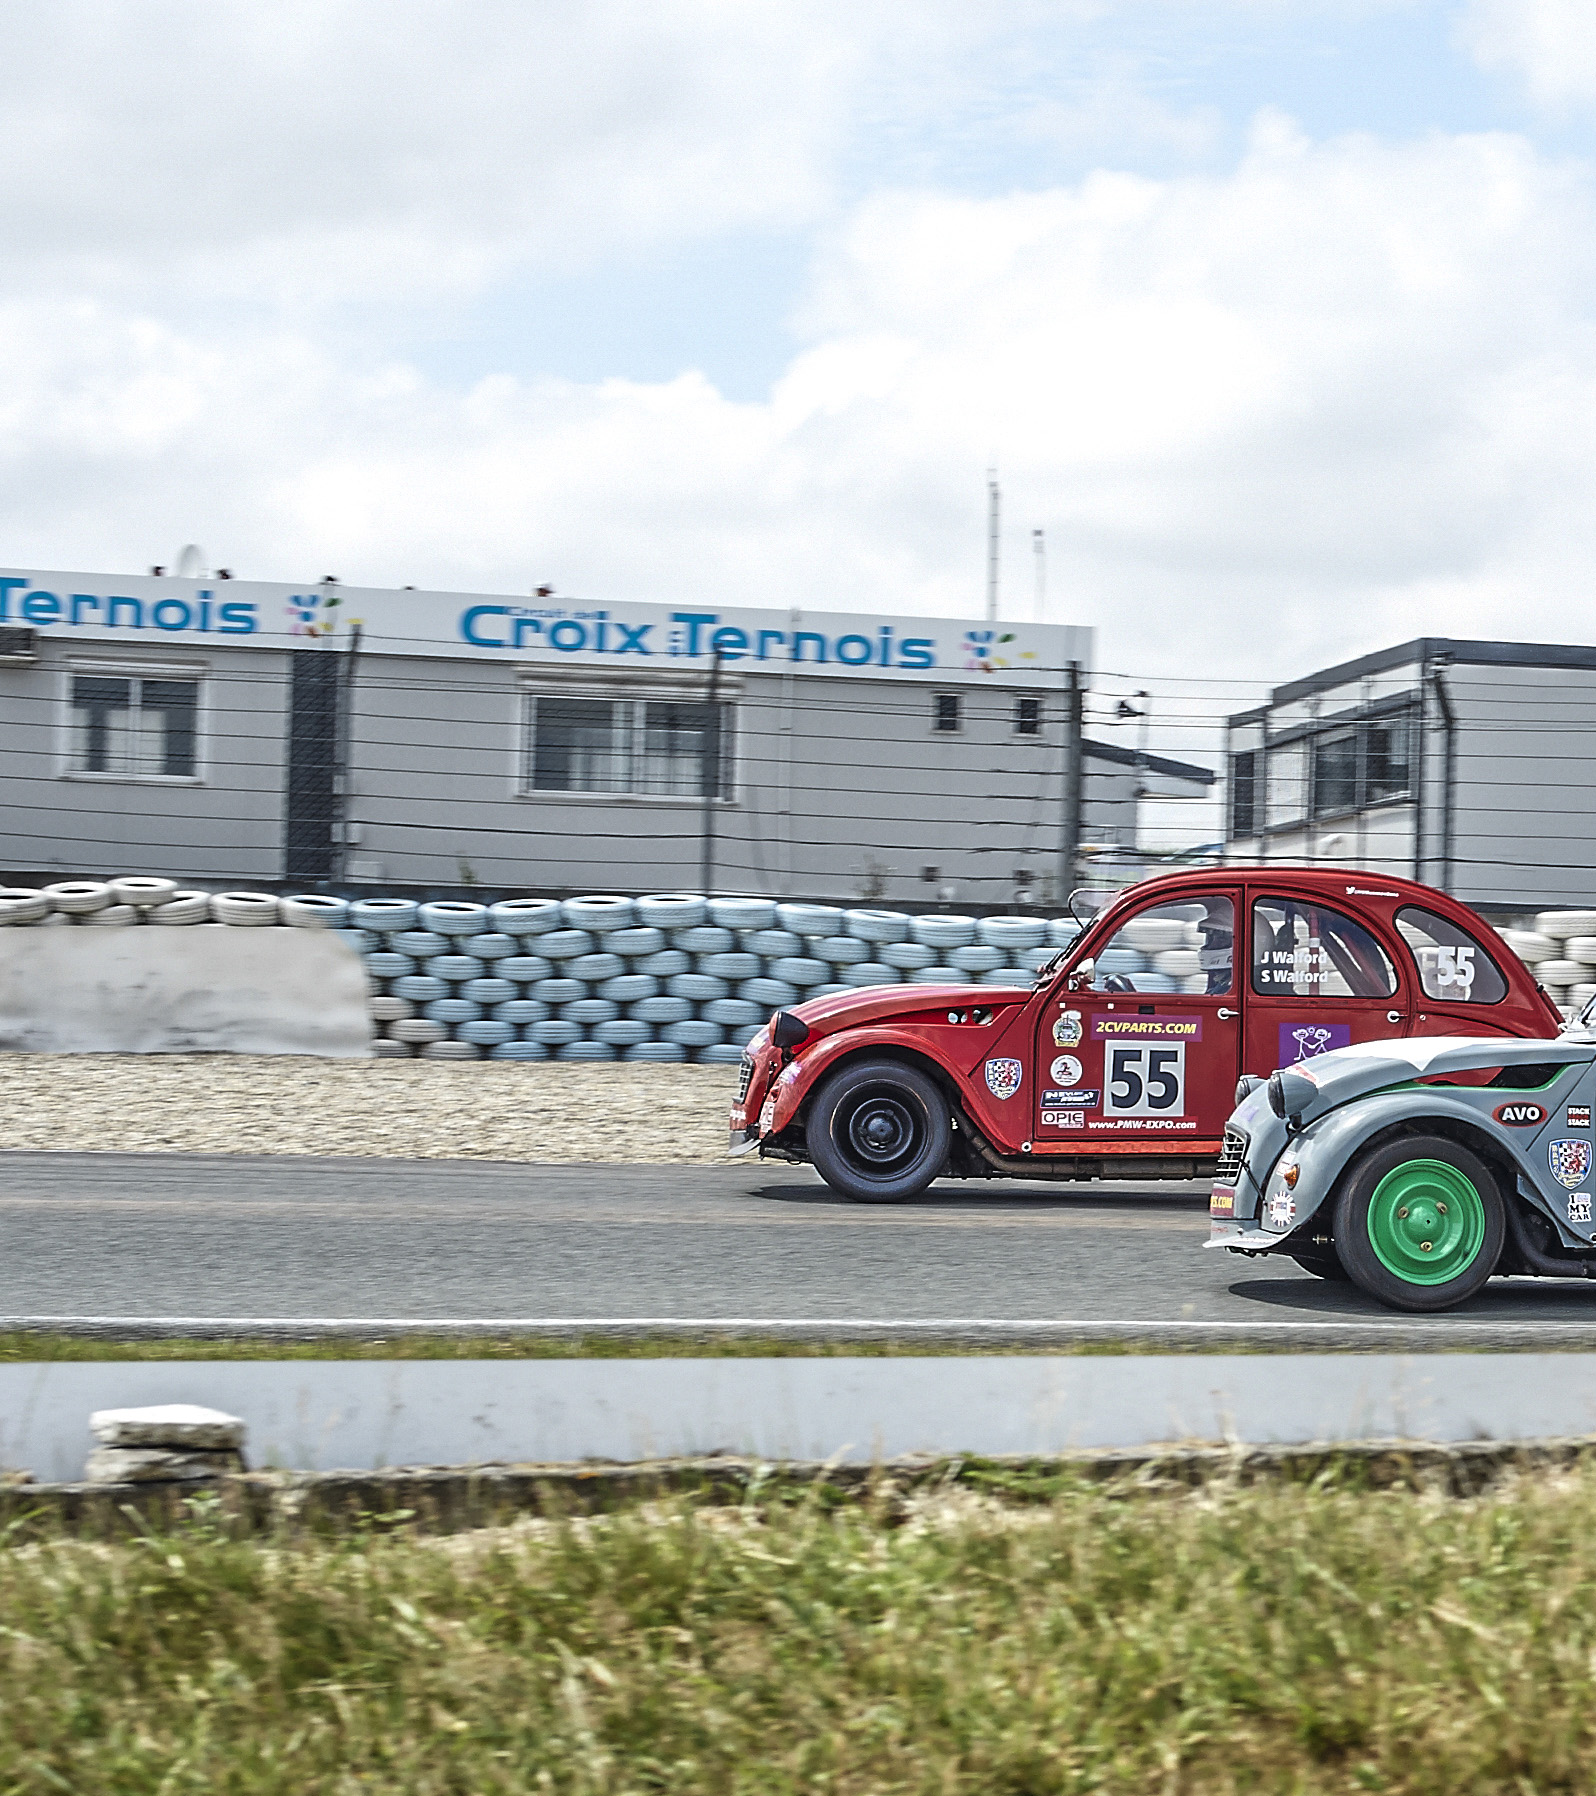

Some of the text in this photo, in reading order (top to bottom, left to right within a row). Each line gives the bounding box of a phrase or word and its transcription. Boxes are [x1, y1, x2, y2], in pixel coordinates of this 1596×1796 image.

[462, 604, 654, 656] Croix
[670, 612, 935, 670] Ternois
[1261, 951, 1328, 964] J Walford
[1437, 945, 1475, 987] 55
[1261, 969, 1328, 983] S Walford
[1096, 1021, 1197, 1034] 2CVPARTS.COM
[1110, 1048, 1179, 1110] 55
[1044, 1112, 1083, 1123] OPIE
[1501, 1106, 1540, 1121] AVO
[1088, 1120, 1197, 1130] www.PMW-EXPO.com
[1569, 1203, 1589, 1214] MY
[1569, 1213, 1590, 1221] CAR
